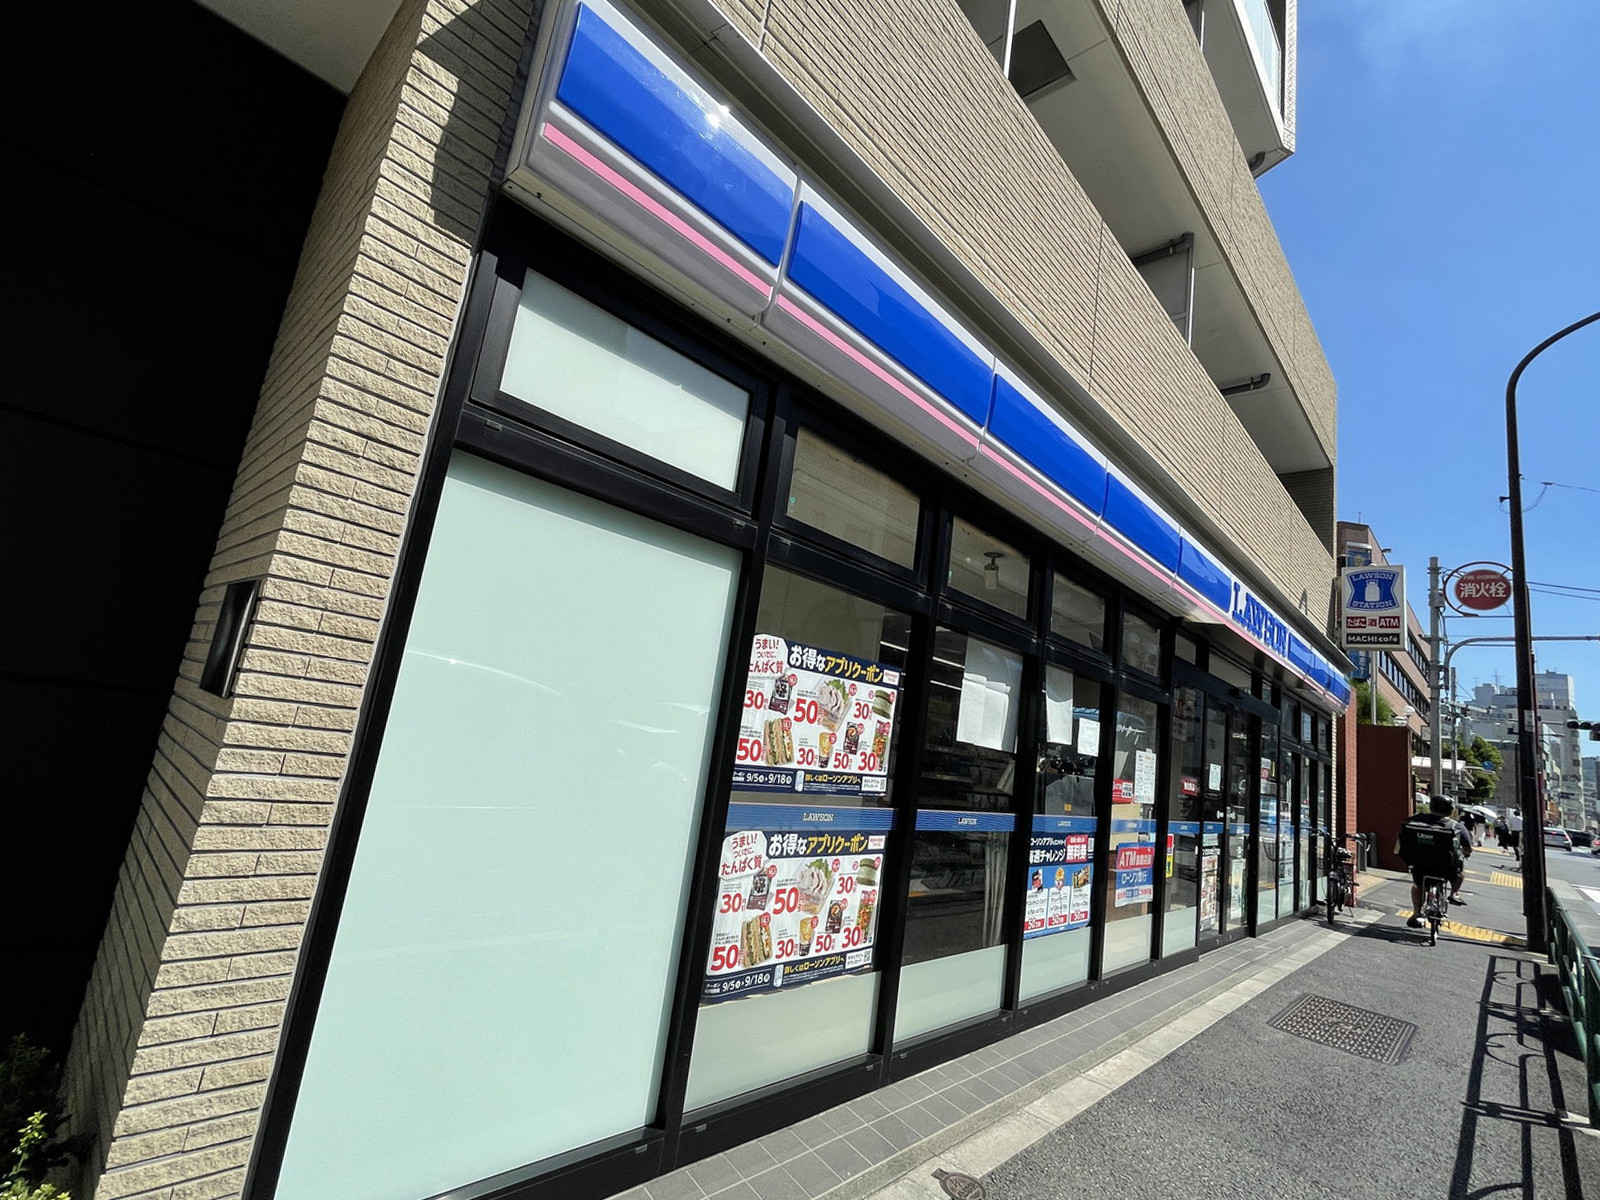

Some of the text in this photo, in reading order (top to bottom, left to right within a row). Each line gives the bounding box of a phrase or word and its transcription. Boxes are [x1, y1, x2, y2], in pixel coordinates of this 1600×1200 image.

[1352, 573, 1393, 581] LAWSON
[1460, 582, 1507, 598] 消火栓
[1351, 600, 1393, 608] STATION
[1232, 581, 1288, 659] LAWSON
[1347, 618, 1367, 627] たばこ
[1379, 618, 1399, 627] ATM
[789, 645, 884, 683] お得なアプリクーポン
[743, 690, 764, 709] 30
[793, 698, 819, 724] 50
[854, 702, 869, 719] 30
[736, 738, 762, 762] 50
[797, 748, 814, 765] 30
[833, 752, 849, 769] 50
[858, 752, 876, 771] 30
[803, 812, 834, 821] LAWSON
[768, 833, 868, 856] お得なアプリクーポン
[721, 854, 763, 876] たんぱく質
[1120, 850, 1137, 867] ATM
[837, 876, 854, 895] 30
[719, 893, 741, 914] 30
[772, 887, 799, 915] 50
[815, 934, 832, 953] 50
[841, 926, 861, 949] 30
[710, 944, 739, 972] 50
[775, 938, 794, 959] 30
